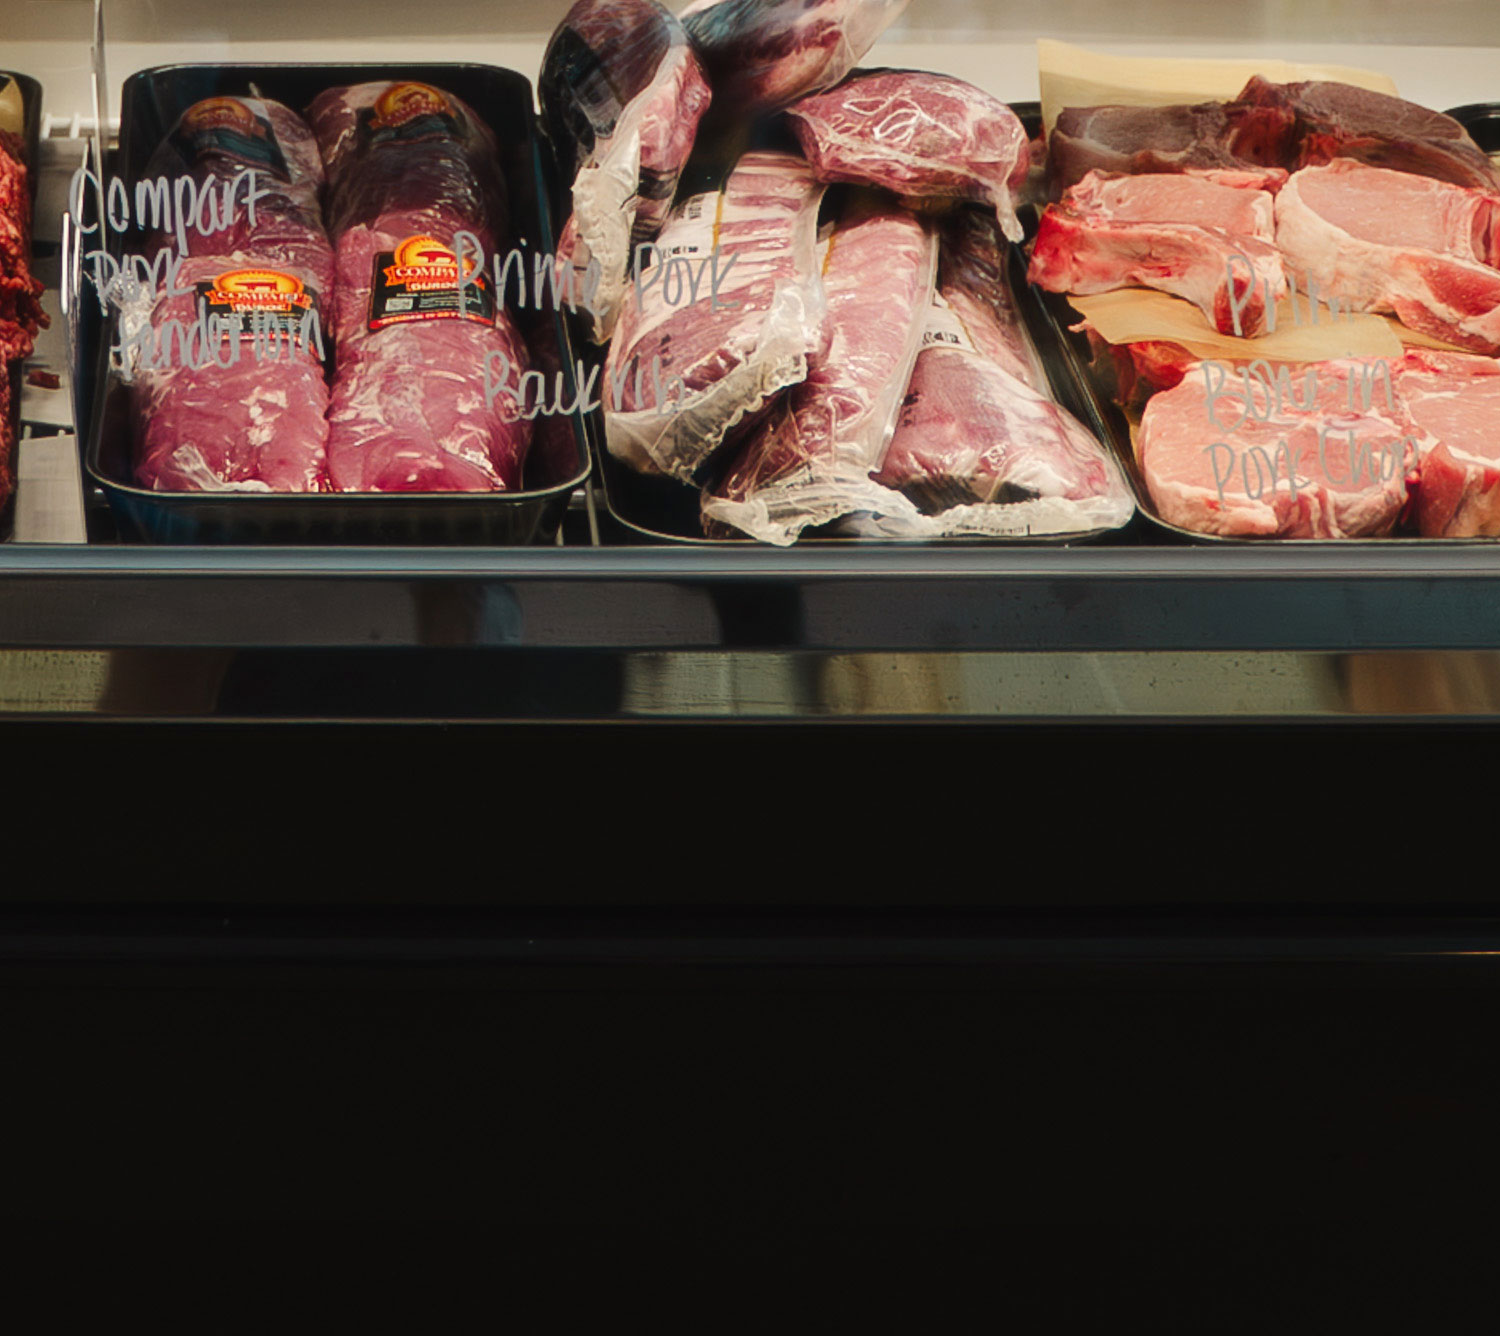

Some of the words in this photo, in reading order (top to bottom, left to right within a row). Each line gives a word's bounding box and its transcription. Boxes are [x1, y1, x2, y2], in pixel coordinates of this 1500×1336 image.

[67, 165, 273, 252] Compart
[451, 229, 614, 319] Prime
[632, 239, 741, 314] Pork
[1202, 439, 1311, 510] Pork
[1319, 426, 1421, 501] Chop
